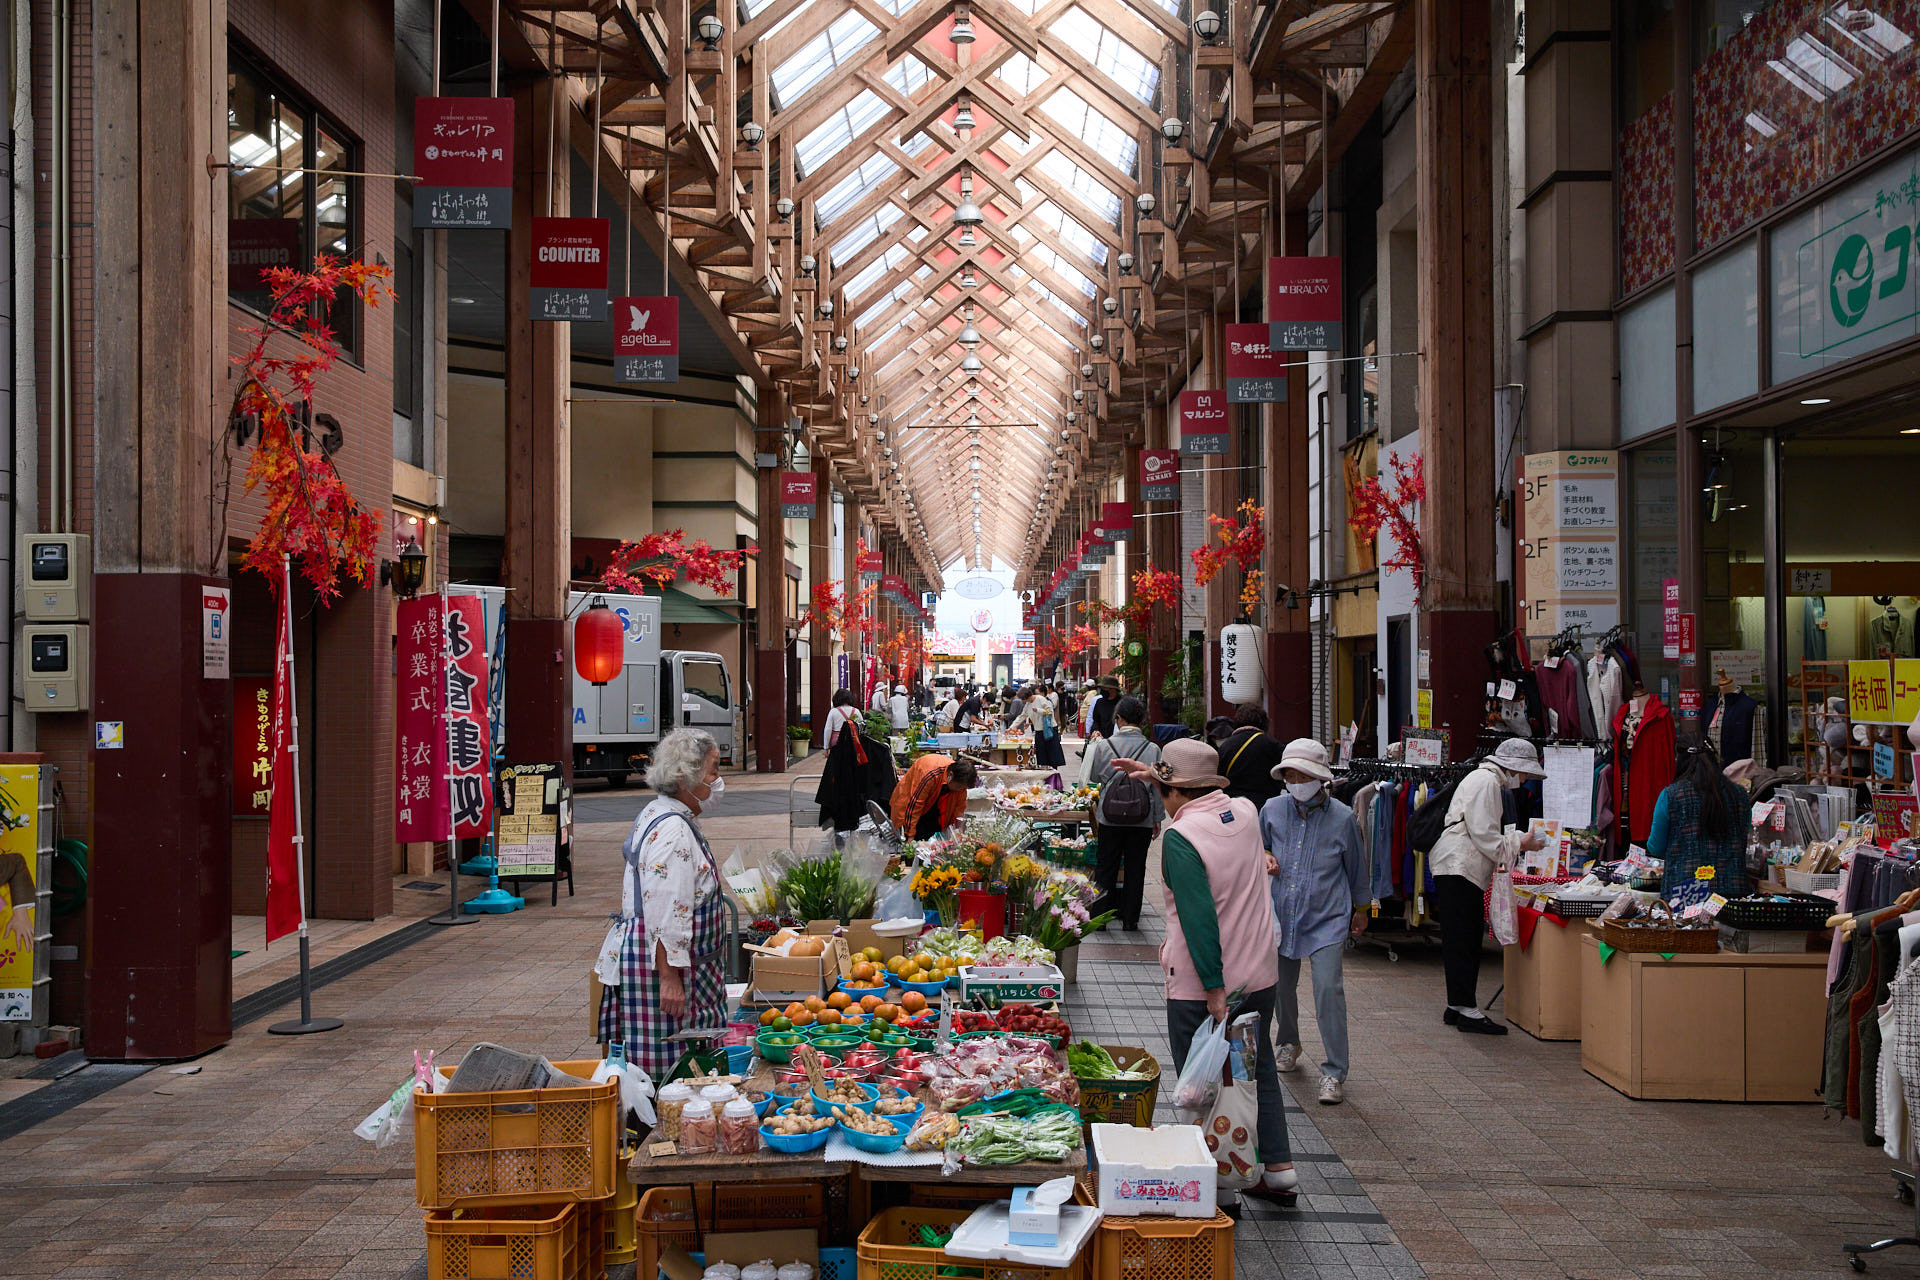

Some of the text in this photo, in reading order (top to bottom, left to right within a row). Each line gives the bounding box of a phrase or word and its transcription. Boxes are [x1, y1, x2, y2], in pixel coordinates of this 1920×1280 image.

[433, 124, 496, 138] ギャレリア
[539, 246, 600, 263] COUNTER
[1879, 221, 1920, 300] コ
[1289, 285, 1330, 294] BRAUNY
[621, 332, 657, 347] ageha
[1184, 410, 1225, 419] マルシン
[1579, 456, 1608, 465] コマドリ
[1525, 475, 1548, 501] 3F
[1563, 485, 1578, 493] 毛糸
[1563, 496, 1594, 504] 手芸材料
[1563, 507, 1606, 515] 手づくり教室
[1563, 518, 1614, 526] お直しコーナー
[1525, 538, 1548, 558] 2F
[1563, 569, 1606, 577] パッチワーク
[1796, 569, 1823, 584] 紳士
[1563, 580, 1613, 588] リフォームコーナー
[1526, 600, 1547, 620] 1F
[1564, 610, 1588, 618] 衣料品
[1226, 632, 1237, 684] 焼きとん
[1852, 676, 1920, 711] 特価 コー
[410, 620, 431, 801] 卒業式 衣裳
[1672, 879, 1709, 898] コンチョ
[1000, 988, 1037, 997] いちじく
[1136, 1184, 1179, 1196] みょうが
